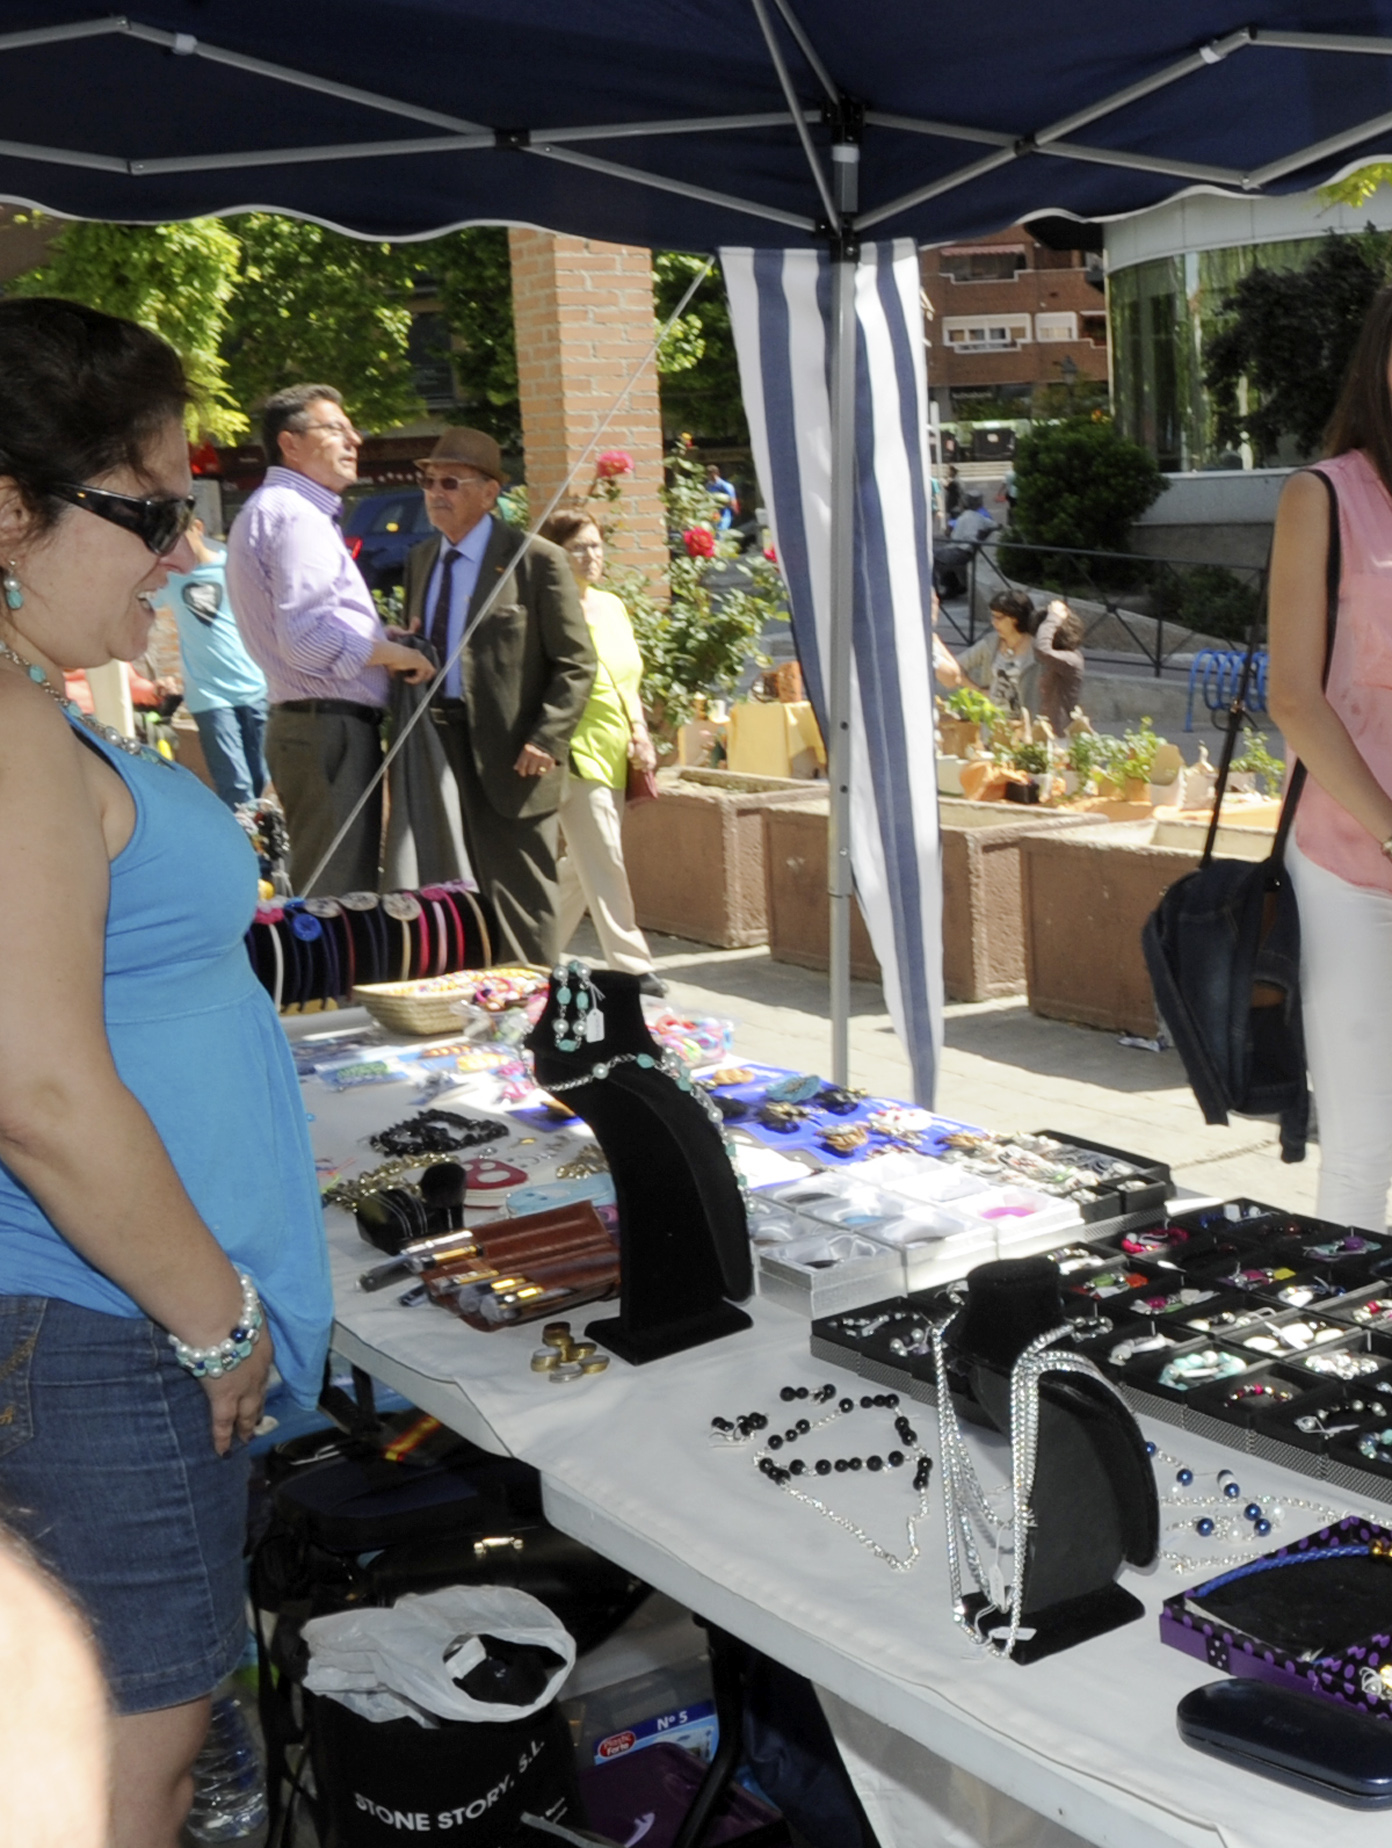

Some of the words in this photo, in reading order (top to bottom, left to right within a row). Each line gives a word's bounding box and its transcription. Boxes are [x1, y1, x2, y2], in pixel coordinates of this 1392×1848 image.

[678, 1710, 689, 1725] 5
[606, 1742, 630, 1756] Forte
[354, 1792, 431, 1832] STONE
[438, 1774, 515, 1830] STORY,
